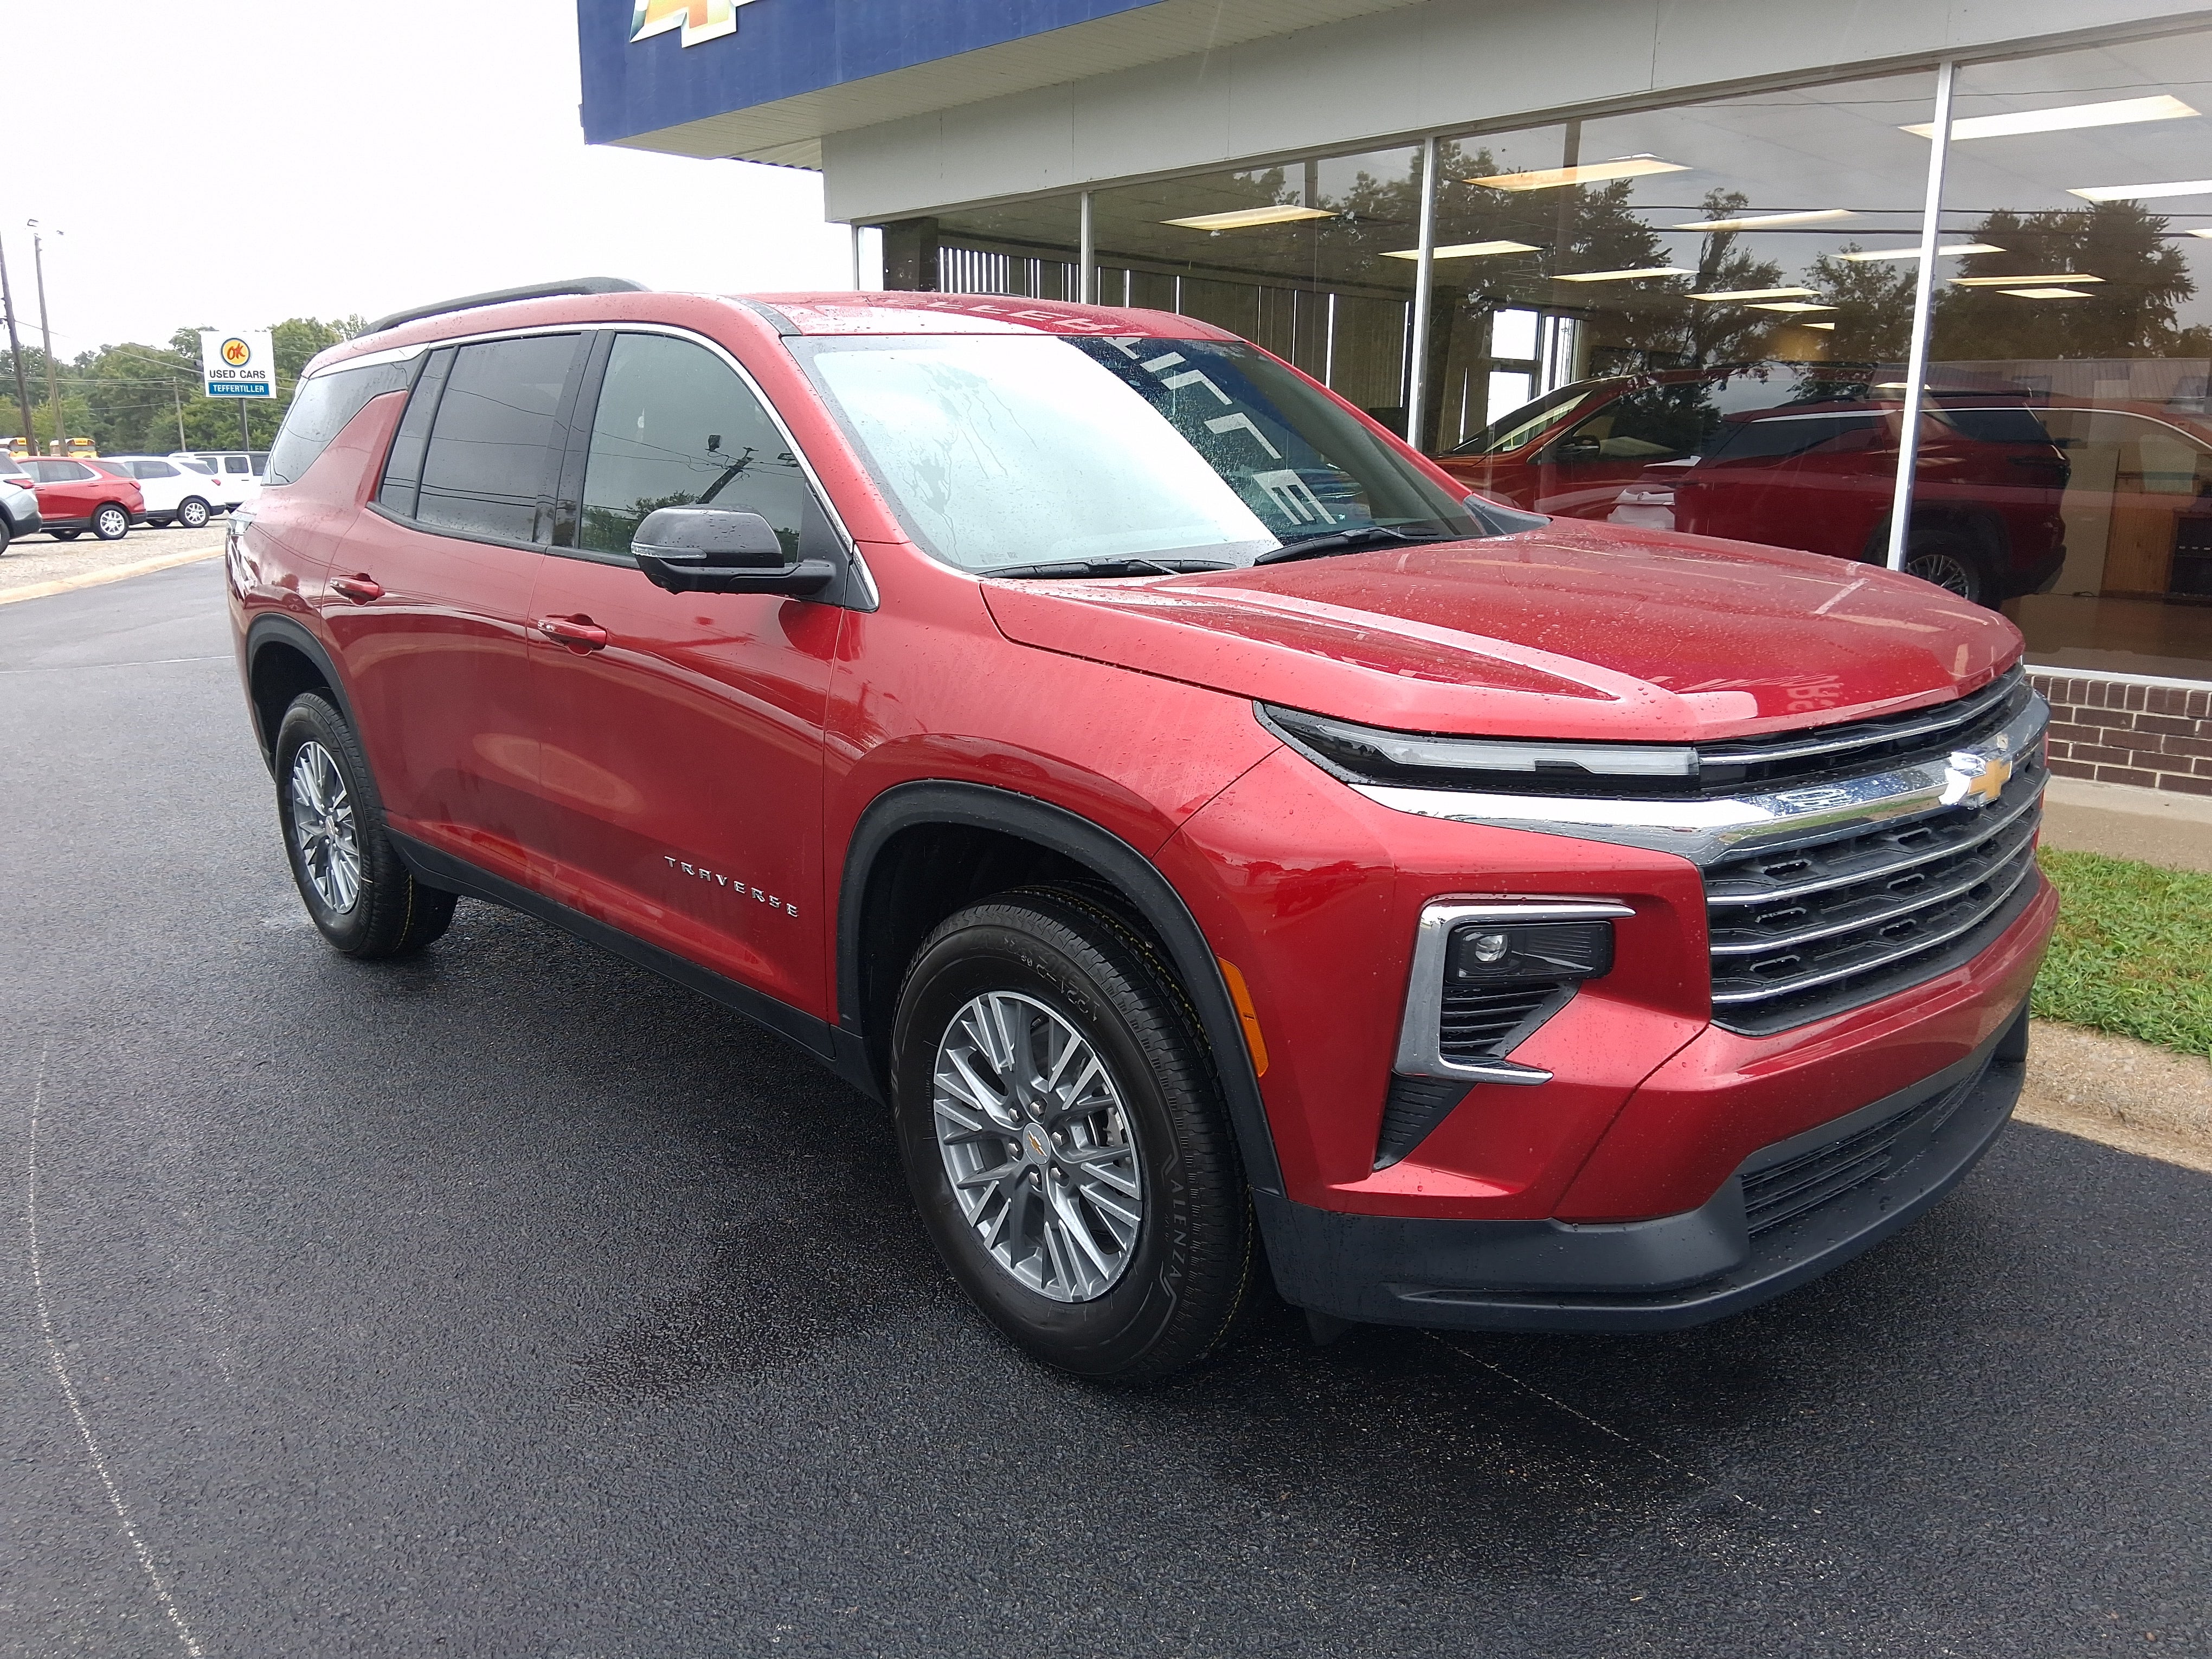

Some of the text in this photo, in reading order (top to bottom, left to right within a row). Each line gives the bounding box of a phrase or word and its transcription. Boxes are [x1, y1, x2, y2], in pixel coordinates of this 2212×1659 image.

[227, 343, 246, 360] OK
[209, 370, 266, 378] USED CARS
[213, 384, 265, 393] TEFFERTILLER
[664, 856, 799, 918] TRAVERSE
[1169, 1179, 1187, 1277] ALENZA
